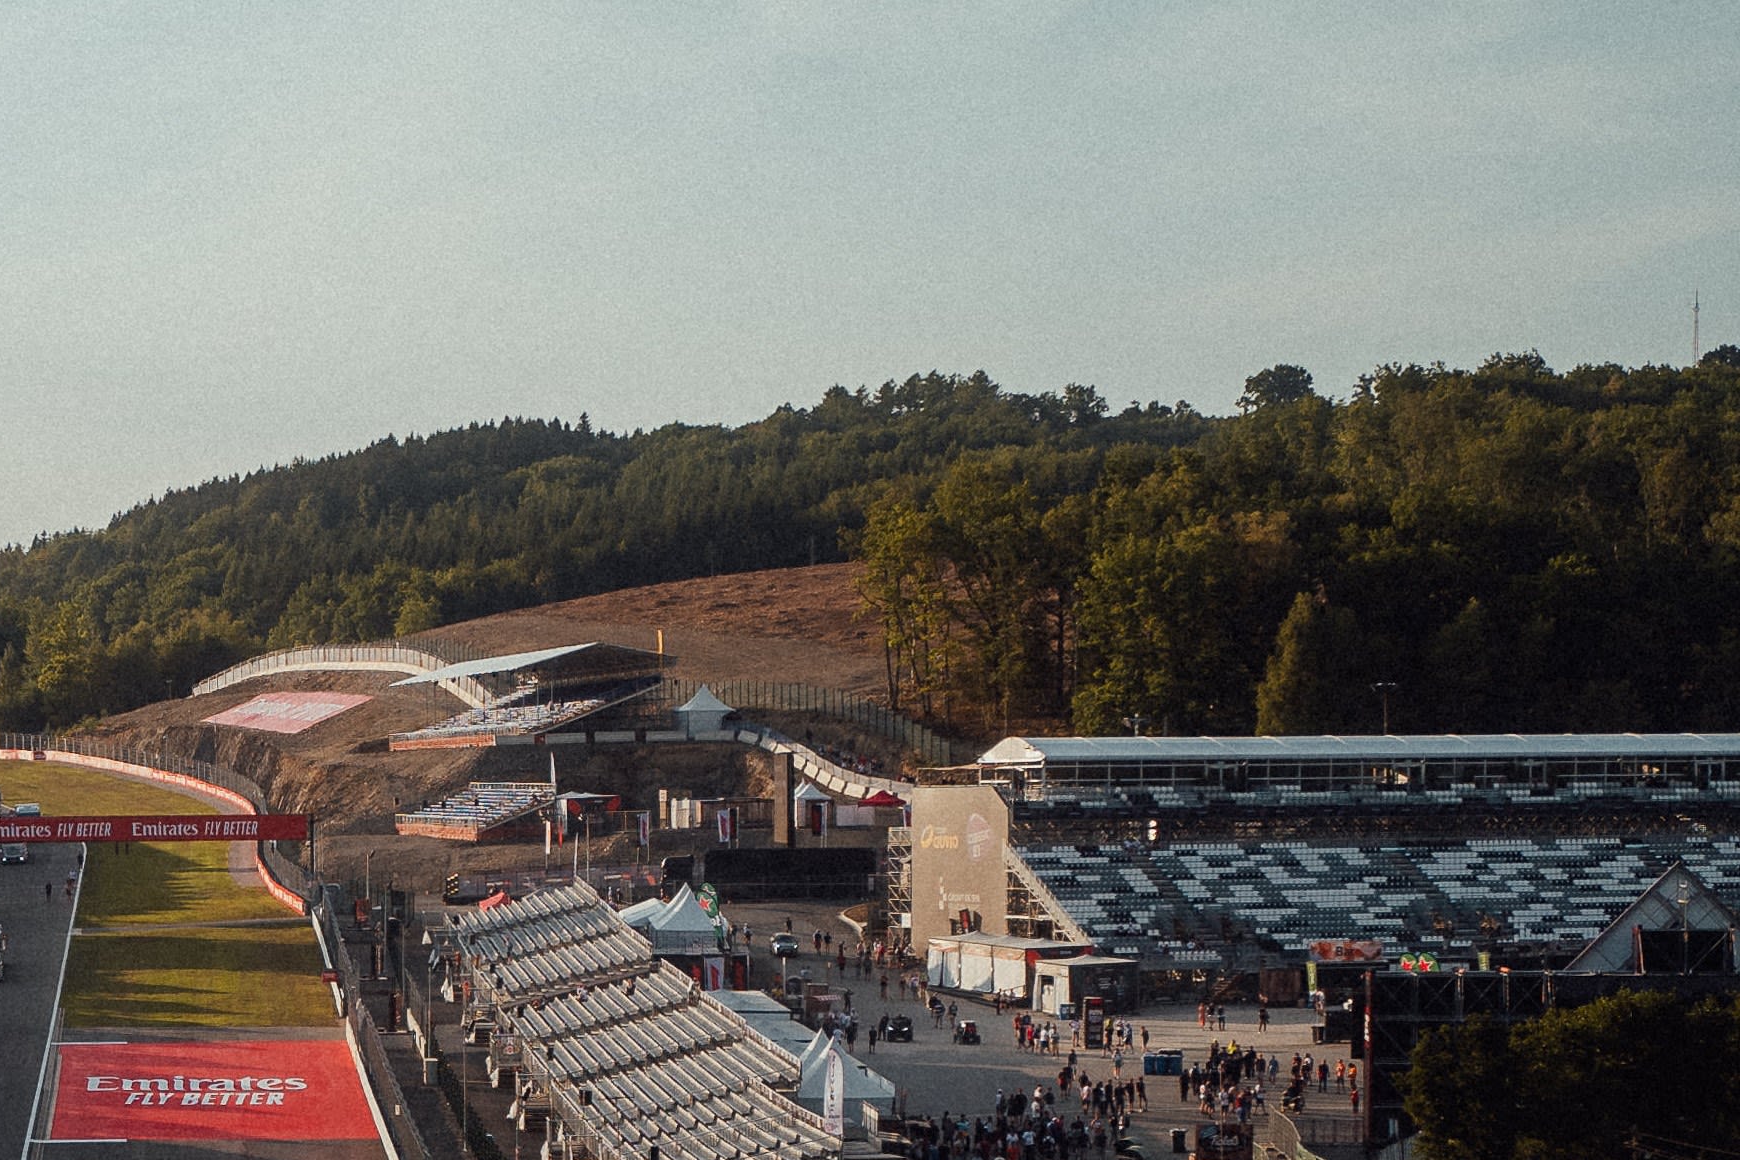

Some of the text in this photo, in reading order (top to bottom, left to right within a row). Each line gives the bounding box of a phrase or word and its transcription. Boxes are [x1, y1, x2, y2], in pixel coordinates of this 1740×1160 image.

[57, 823, 74, 838] FLY
[76, 822, 111, 837] BETTER
[131, 821, 199, 837] Emirates
[204, 821, 221, 836] FLY
[223, 820, 259, 835] BETTER
[85, 1075, 308, 1092] Emirates
[125, 1092, 285, 1106] FLY BETTER
